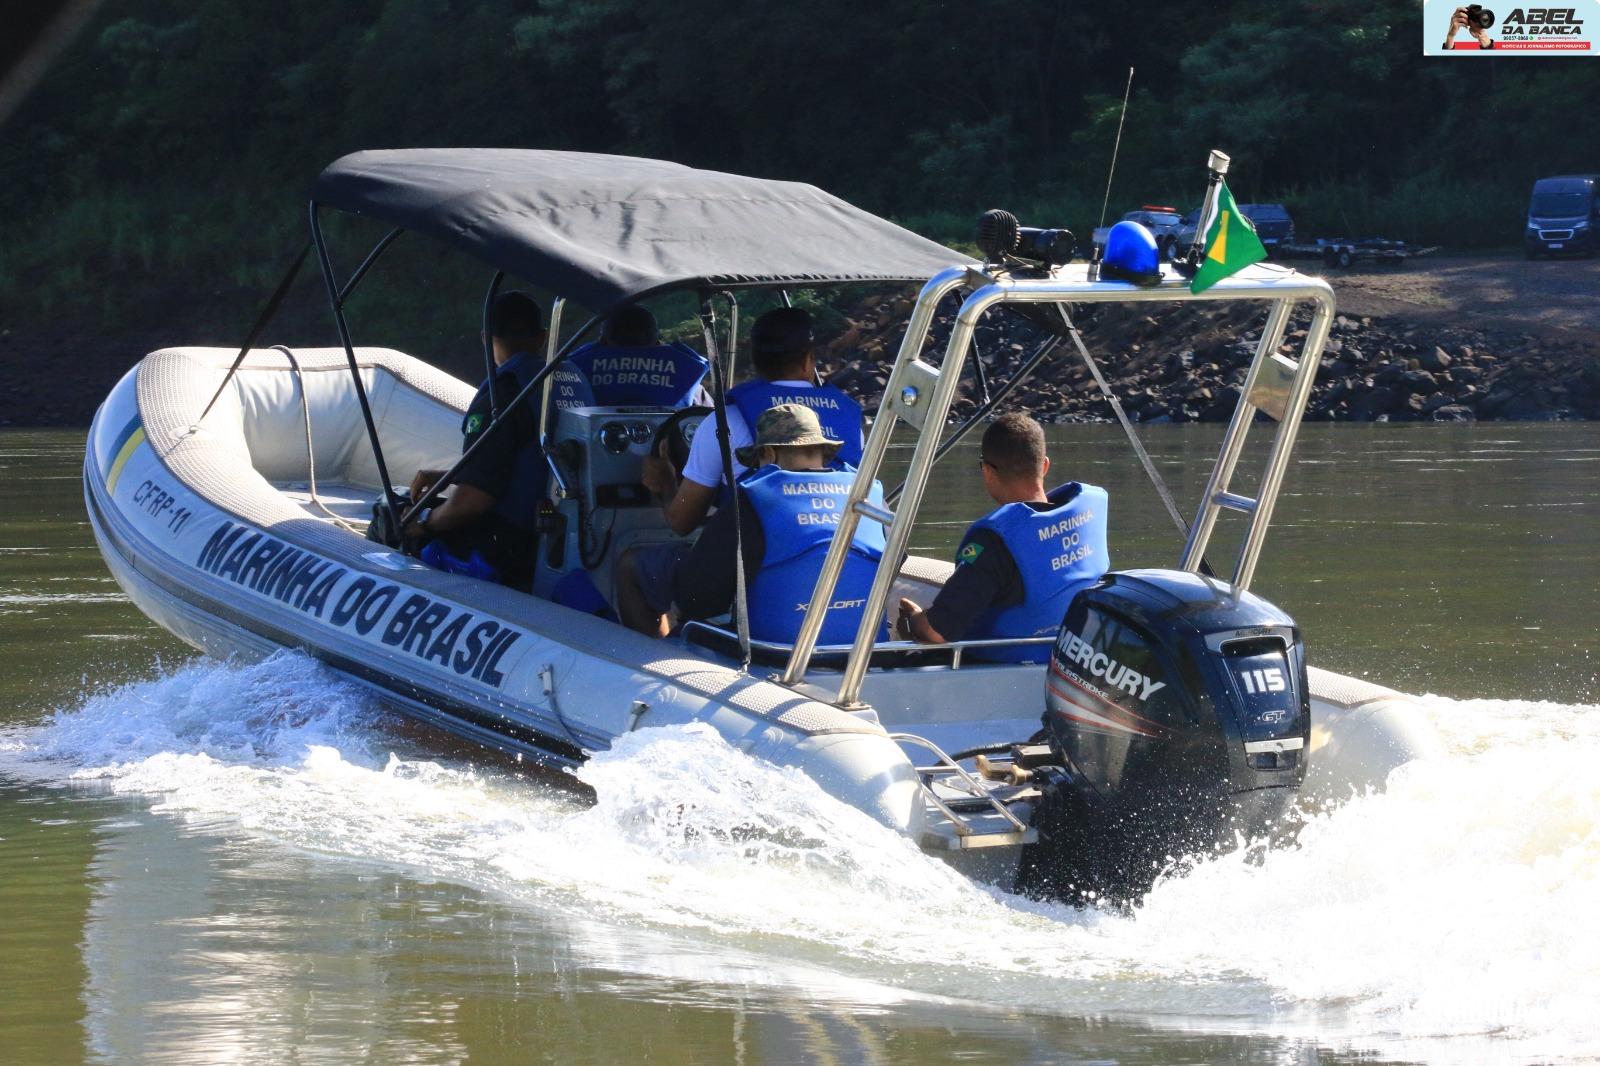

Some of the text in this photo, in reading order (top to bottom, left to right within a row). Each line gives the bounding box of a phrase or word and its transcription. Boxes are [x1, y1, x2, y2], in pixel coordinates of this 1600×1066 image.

[592, 357, 676, 374] MARINHA
[592, 372, 675, 389] DO BRASIL
[560, 385, 574, 397] DO
[771, 396, 839, 411] MARINHA
[133, 480, 191, 533] CFRP-11
[811, 497, 835, 510] DO
[797, 512, 841, 525] BRAS
[1038, 509, 1095, 541] MARINHA
[1061, 532, 1080, 550] DO
[1051, 543, 1094, 571] BRASIL
[197, 521, 523, 689] MARINHA DO BRASIL
[1057, 625, 1166, 701] MERCURY
[1241, 668, 1286, 694] 115
[1261, 710, 1286, 722] GT
